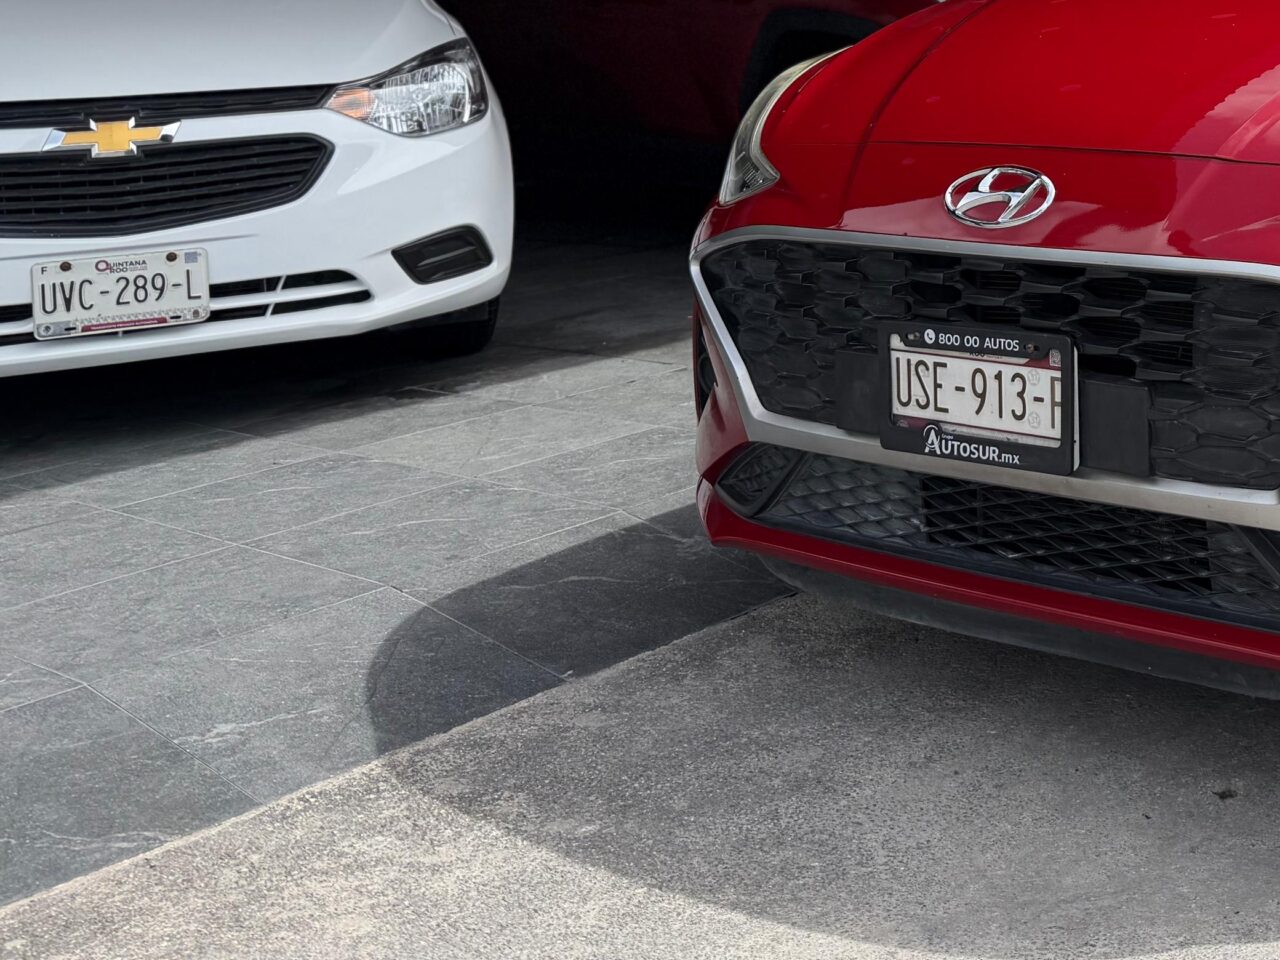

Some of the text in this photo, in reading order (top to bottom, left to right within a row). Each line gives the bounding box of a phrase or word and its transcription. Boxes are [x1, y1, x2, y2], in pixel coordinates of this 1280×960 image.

[95, 259, 147, 273] QUINTANA
[109, 266, 128, 274] ROO
[40, 269, 202, 314] UVC-289-L
[938, 333, 1020, 352] 800 00 AUTOS
